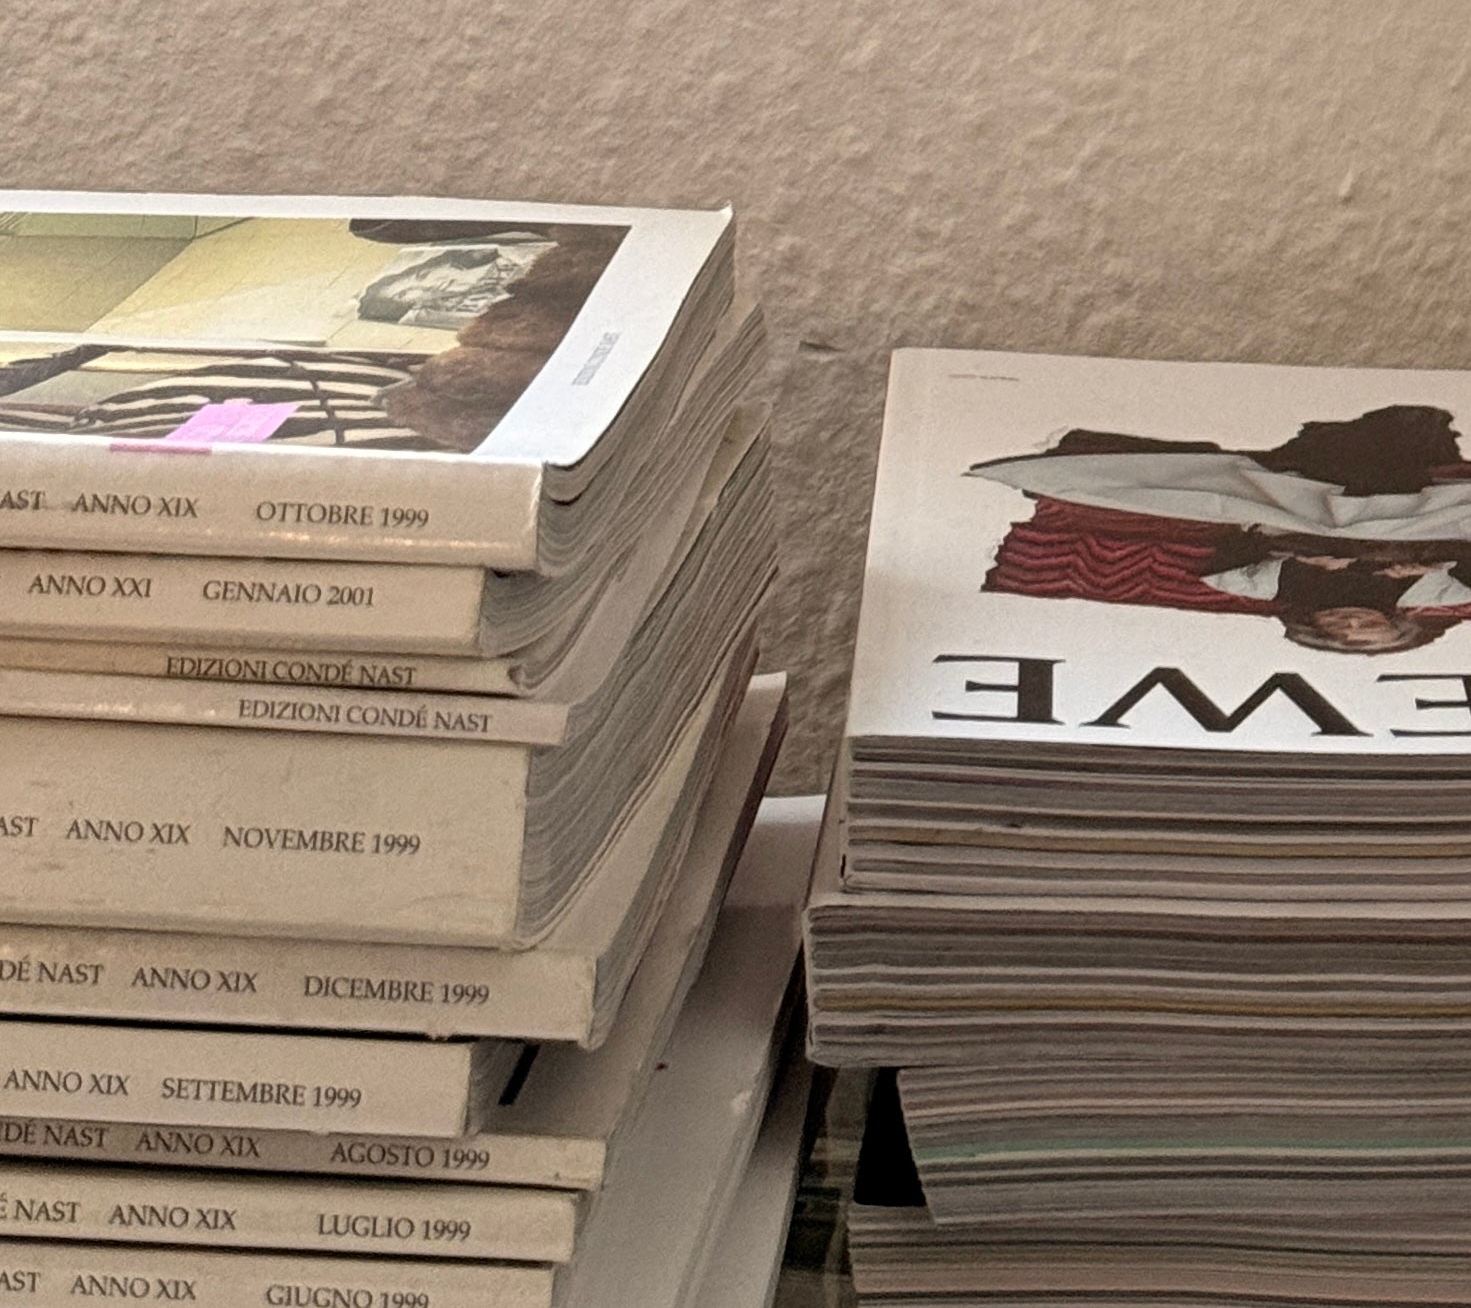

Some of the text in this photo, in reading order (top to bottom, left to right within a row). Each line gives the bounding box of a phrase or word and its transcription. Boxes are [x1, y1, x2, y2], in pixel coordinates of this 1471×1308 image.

[71, 493, 151, 516] ANNO
[157, 497, 199, 519] XIX
[255, 501, 374, 526] OTTOBRE
[380, 507, 430, 528] 1999
[27, 574, 375, 607] ANNO XXI GENNAIO 2001
[166, 656, 417, 686] EDIZIONI CONDÉ NAST
[238, 698, 493, 733] EDIZIONI CONDÉ NAST
[65, 819, 145, 843] ANNO
[149, 822, 192, 845] XIX
[222, 825, 367, 854] NOVEMBRE
[372, 833, 422, 855] 1999
[36, 960, 104, 986] NAST
[131, 967, 212, 991] ANNO
[217, 970, 258, 994] XIX
[303, 975, 434, 1004] DICEMBRE
[440, 983, 490, 1006] 1999
[4, 1070, 362, 1110] ANNO XIX SETTEMBRE 1999
[42, 1124, 110, 1149] NAST
[134, 1131, 215, 1155] ANNO
[220, 1135, 262, 1158] XIX
[329, 1142, 435, 1168] AGOSTO
[441, 1148, 491, 1171] 1999
[13, 1199, 81, 1223] NAST
[107, 1204, 190, 1229] ANNO
[194, 1208, 237, 1231] XIX
[317, 1213, 416, 1240] LUGLIO
[421, 1219, 472, 1243] 1999
[69, 1274, 150, 1299] ANNO
[155, 1278, 198, 1301] XIX
[265, 1284, 374, 1308] GIUGNO
[379, 1291, 430, 1308] 1999
